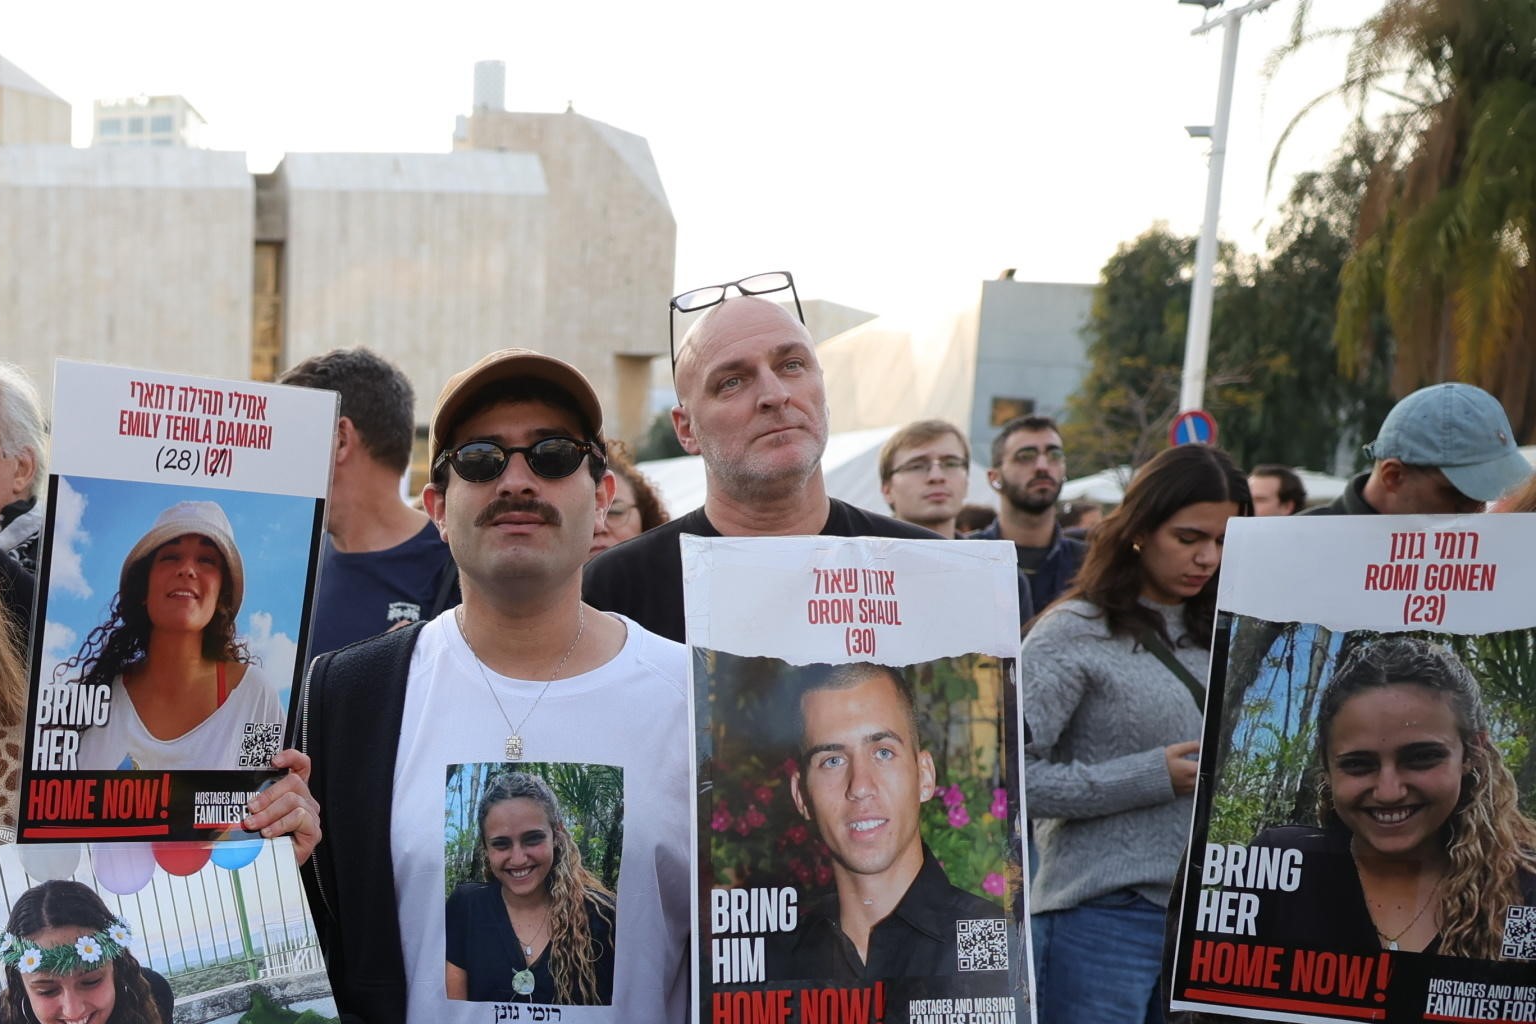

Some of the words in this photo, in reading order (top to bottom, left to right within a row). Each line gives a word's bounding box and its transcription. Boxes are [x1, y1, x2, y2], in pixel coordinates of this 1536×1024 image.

[130, 381, 175, 410] דמארי
[178, 386, 224, 416] תהילה
[228, 391, 267, 421] אמילי
[119, 410, 162, 438] EMILY
[165, 414, 212, 444] TEHILA
[216, 420, 273, 450] DAMARI
[155, 446, 200, 475] (28)
[1390, 532, 1426, 562] גונן
[1434, 532, 1479, 559] רומי
[813, 567, 858, 594] שאול
[862, 568, 895, 596] אורון
[1364, 564, 1420, 591] ROMI
[1424, 563, 1497, 591] GONEN
[808, 598, 854, 625] ORON
[858, 598, 902, 625] SHAUL
[1403, 593, 1446, 625] (23)
[845, 627, 876, 657] (30)
[37, 684, 111, 726] BRING
[31, 726, 79, 770] HER
[27, 779, 97, 821] HOME
[102, 773, 172, 820] NOW!
[194, 791, 230, 804] HOSTAGES
[230, 791, 245, 804] AND
[194, 805, 241, 824] FAMILIES
[1201, 842, 1304, 892] BRING
[711, 886, 798, 935] BRING
[1195, 889, 1260, 936] HER
[712, 937, 766, 984] HIM
[1189, 939, 1284, 990] HOME
[1290, 949, 1392, 1003] NOW!
[1428, 978, 1486, 998] HOSTAGES
[1487, 984, 1512, 1000] AND
[494, 1005, 520, 1024] גונן
[527, 1006, 561, 1021] רומי
[909, 999, 953, 1015] HOSTAGES
[954, 998, 972, 1013] AND
[974, 997, 1016, 1012] MISSING
[1425, 993, 1500, 1020] FAMILIES
[1502, 1000, 1536, 1023] FOR
